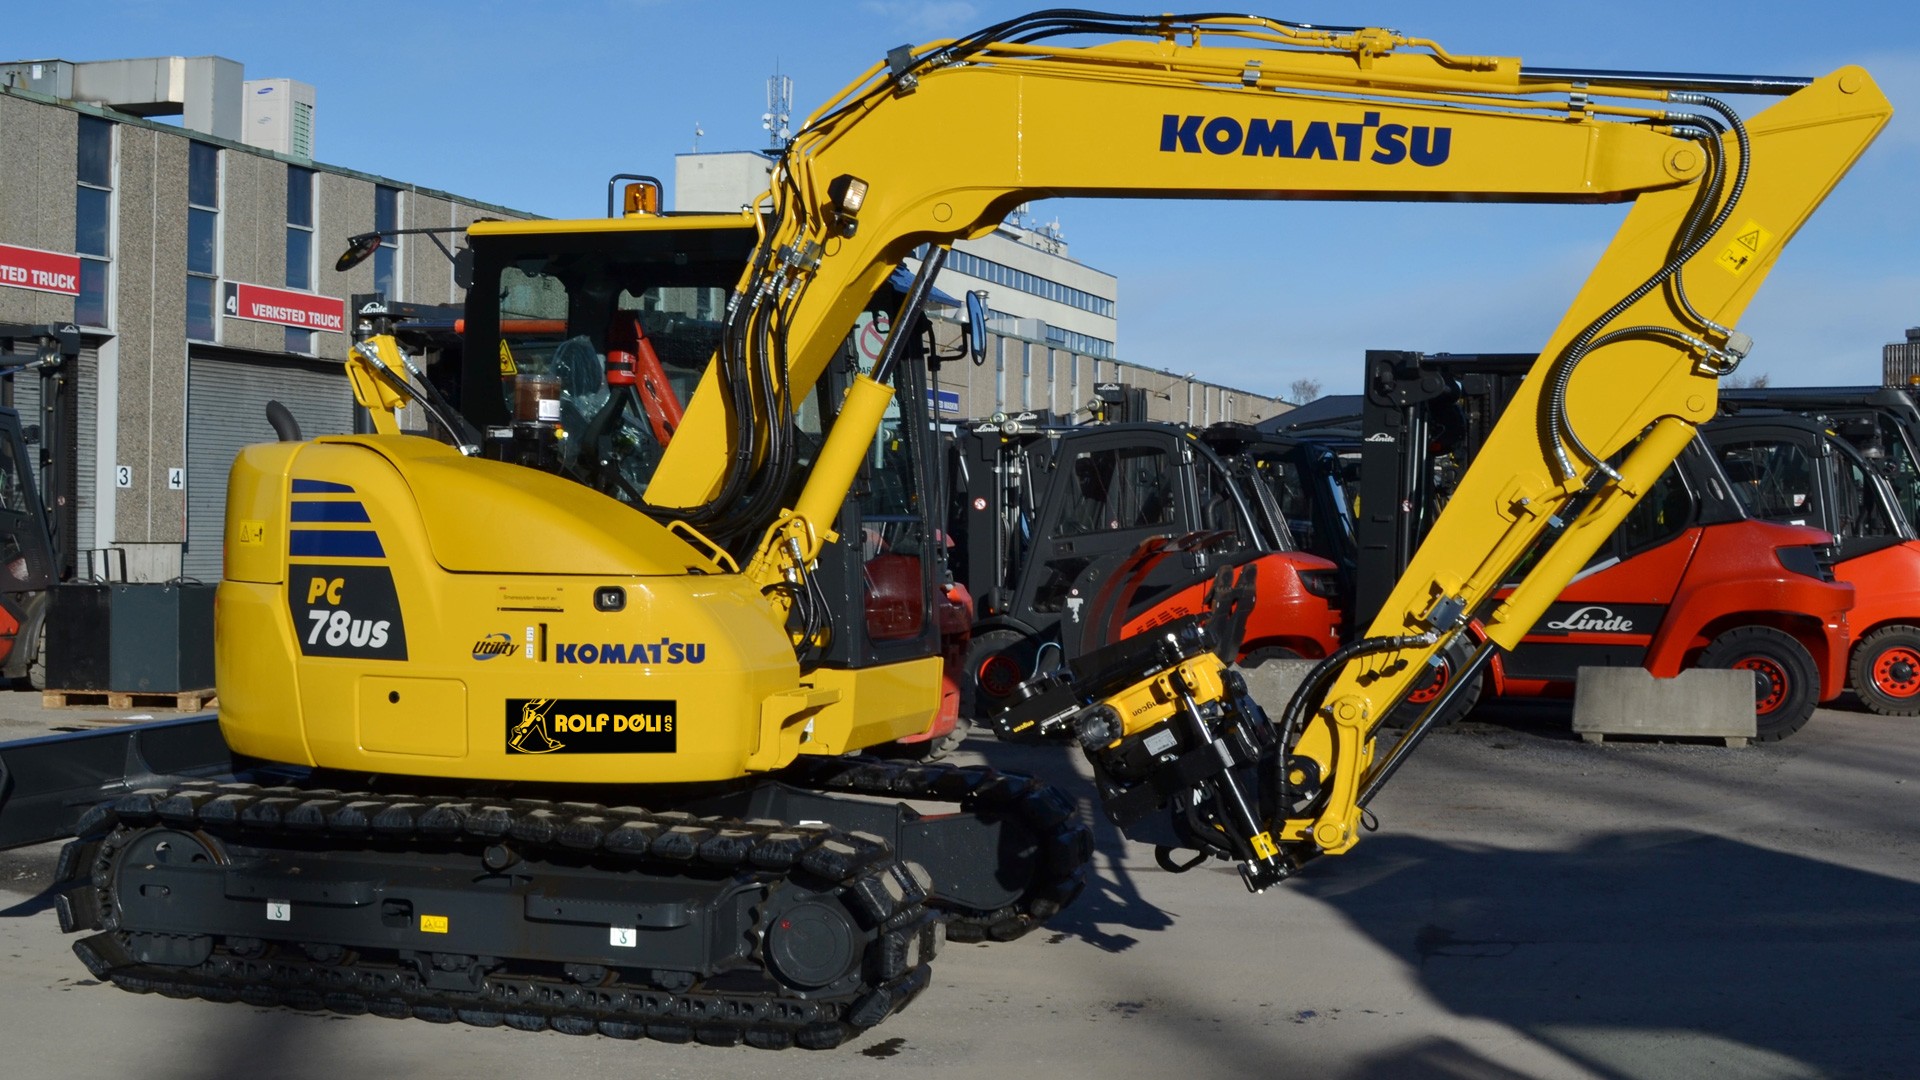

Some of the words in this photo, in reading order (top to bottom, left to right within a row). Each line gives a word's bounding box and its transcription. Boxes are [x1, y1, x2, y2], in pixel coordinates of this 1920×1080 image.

[1160, 111, 1452, 167] KOMATSU
[31, 269, 76, 290] TRUCK
[226, 295, 237, 313] 4
[251, 303, 306, 323] VERKSTED
[308, 311, 342, 329] TRUCK
[359, 301, 388, 314] Linde
[1365, 432, 1395, 443] Linde
[119, 467, 129, 486] 3
[171, 470, 182, 488] 4
[307, 577, 345, 606] PC
[1548, 606, 1633, 632] Linde
[472, 641, 520, 657] Utility
[556, 637, 706, 664] KOMATSU
[554, 713, 610, 733] ROLF
[613, 713, 662, 733] DØLI
